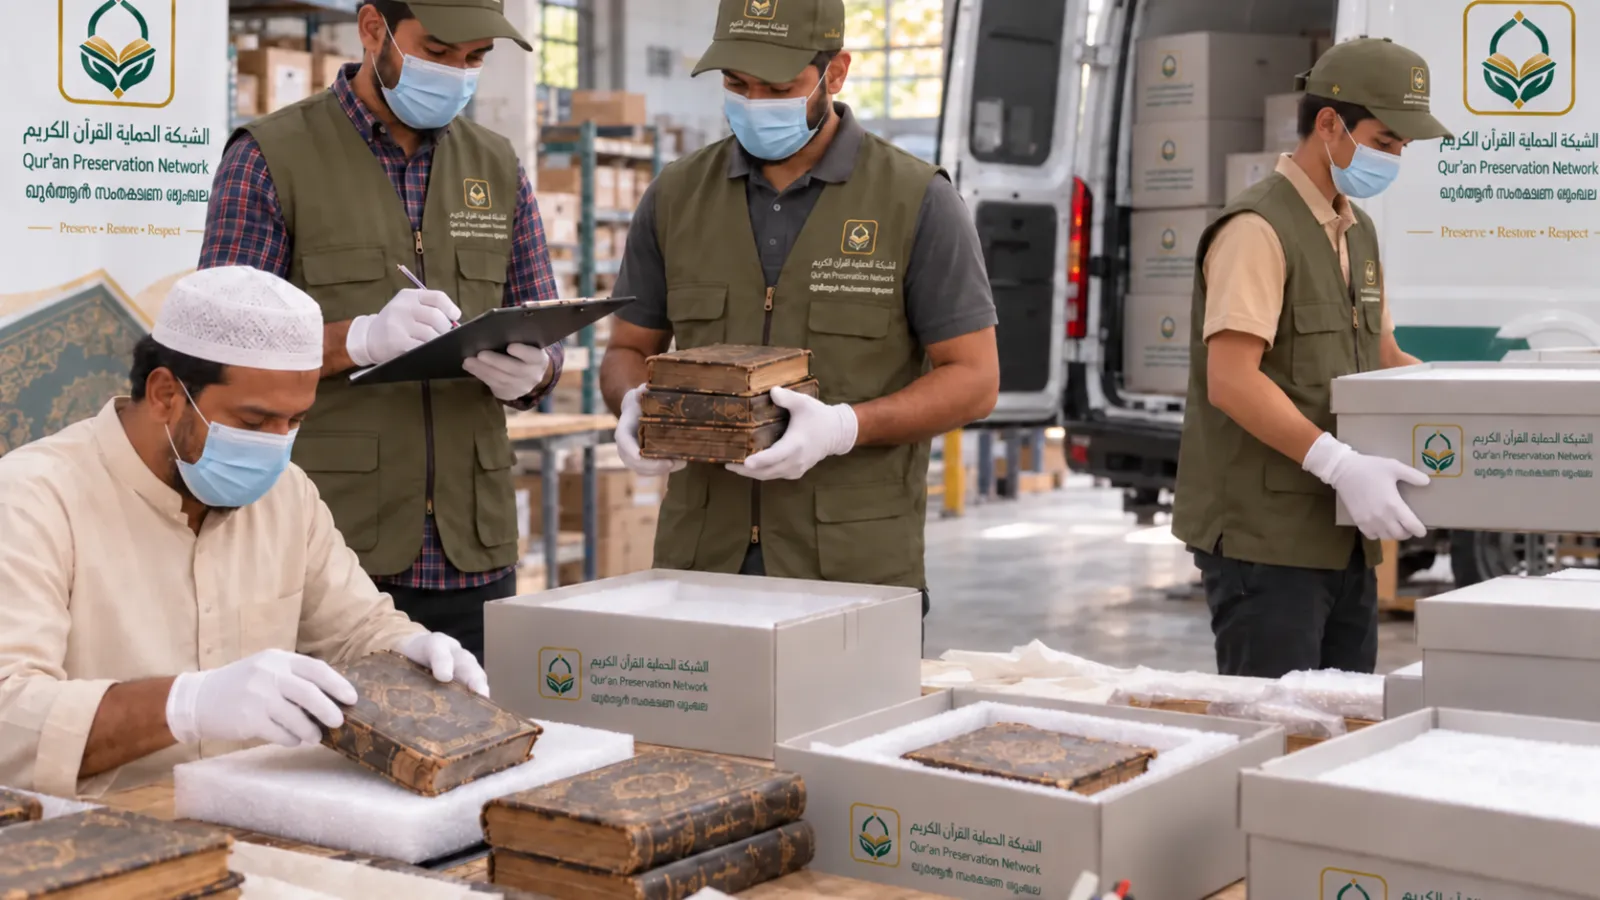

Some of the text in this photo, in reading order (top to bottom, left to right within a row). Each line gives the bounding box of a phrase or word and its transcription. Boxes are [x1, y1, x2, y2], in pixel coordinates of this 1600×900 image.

[23, 120, 69, 144] الكريم
[1439, 131, 1478, 152] الكريم
[73, 154, 154, 172] Preservation
[158, 158, 209, 174] Network
[1480, 160, 1550, 175] Preservation
[1552, 161, 1599, 175] Network
[59, 222, 181, 238] Preserve Restore Respect
[1441, 226, 1589, 241] Preserve Restore Respect
[1503, 450, 1555, 460] Preservation
[1557, 452, 1593, 461] Network
[619, 675, 670, 689] Preservation
[673, 680, 708, 692] Network
[943, 846, 999, 867] Preservation
[1002, 857, 1042, 875] Network
